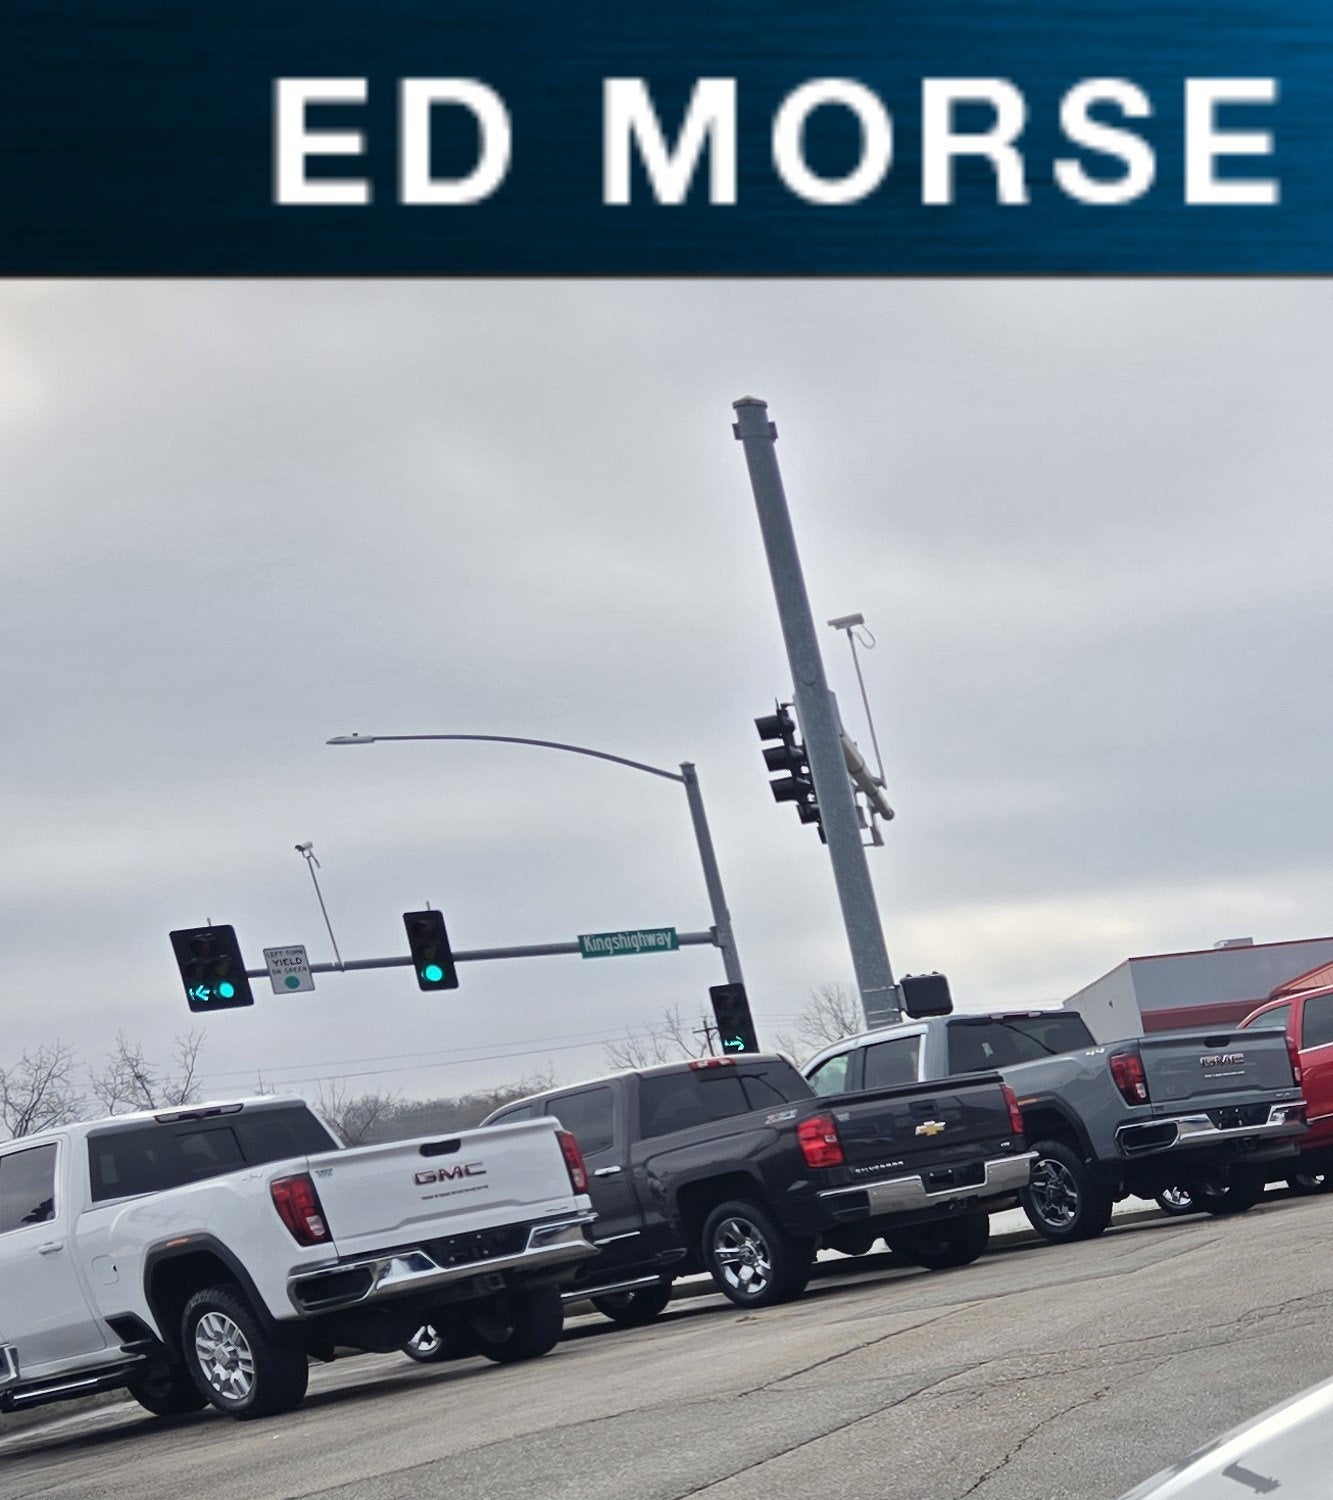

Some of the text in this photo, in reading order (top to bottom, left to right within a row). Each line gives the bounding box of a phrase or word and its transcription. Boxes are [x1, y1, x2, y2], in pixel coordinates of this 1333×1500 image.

[583, 931, 673, 955] Kingshighway
[272, 957, 302, 966] YIELD
[1199, 1053, 1245, 1068] GMC
[414, 1161, 488, 1186] GMC
